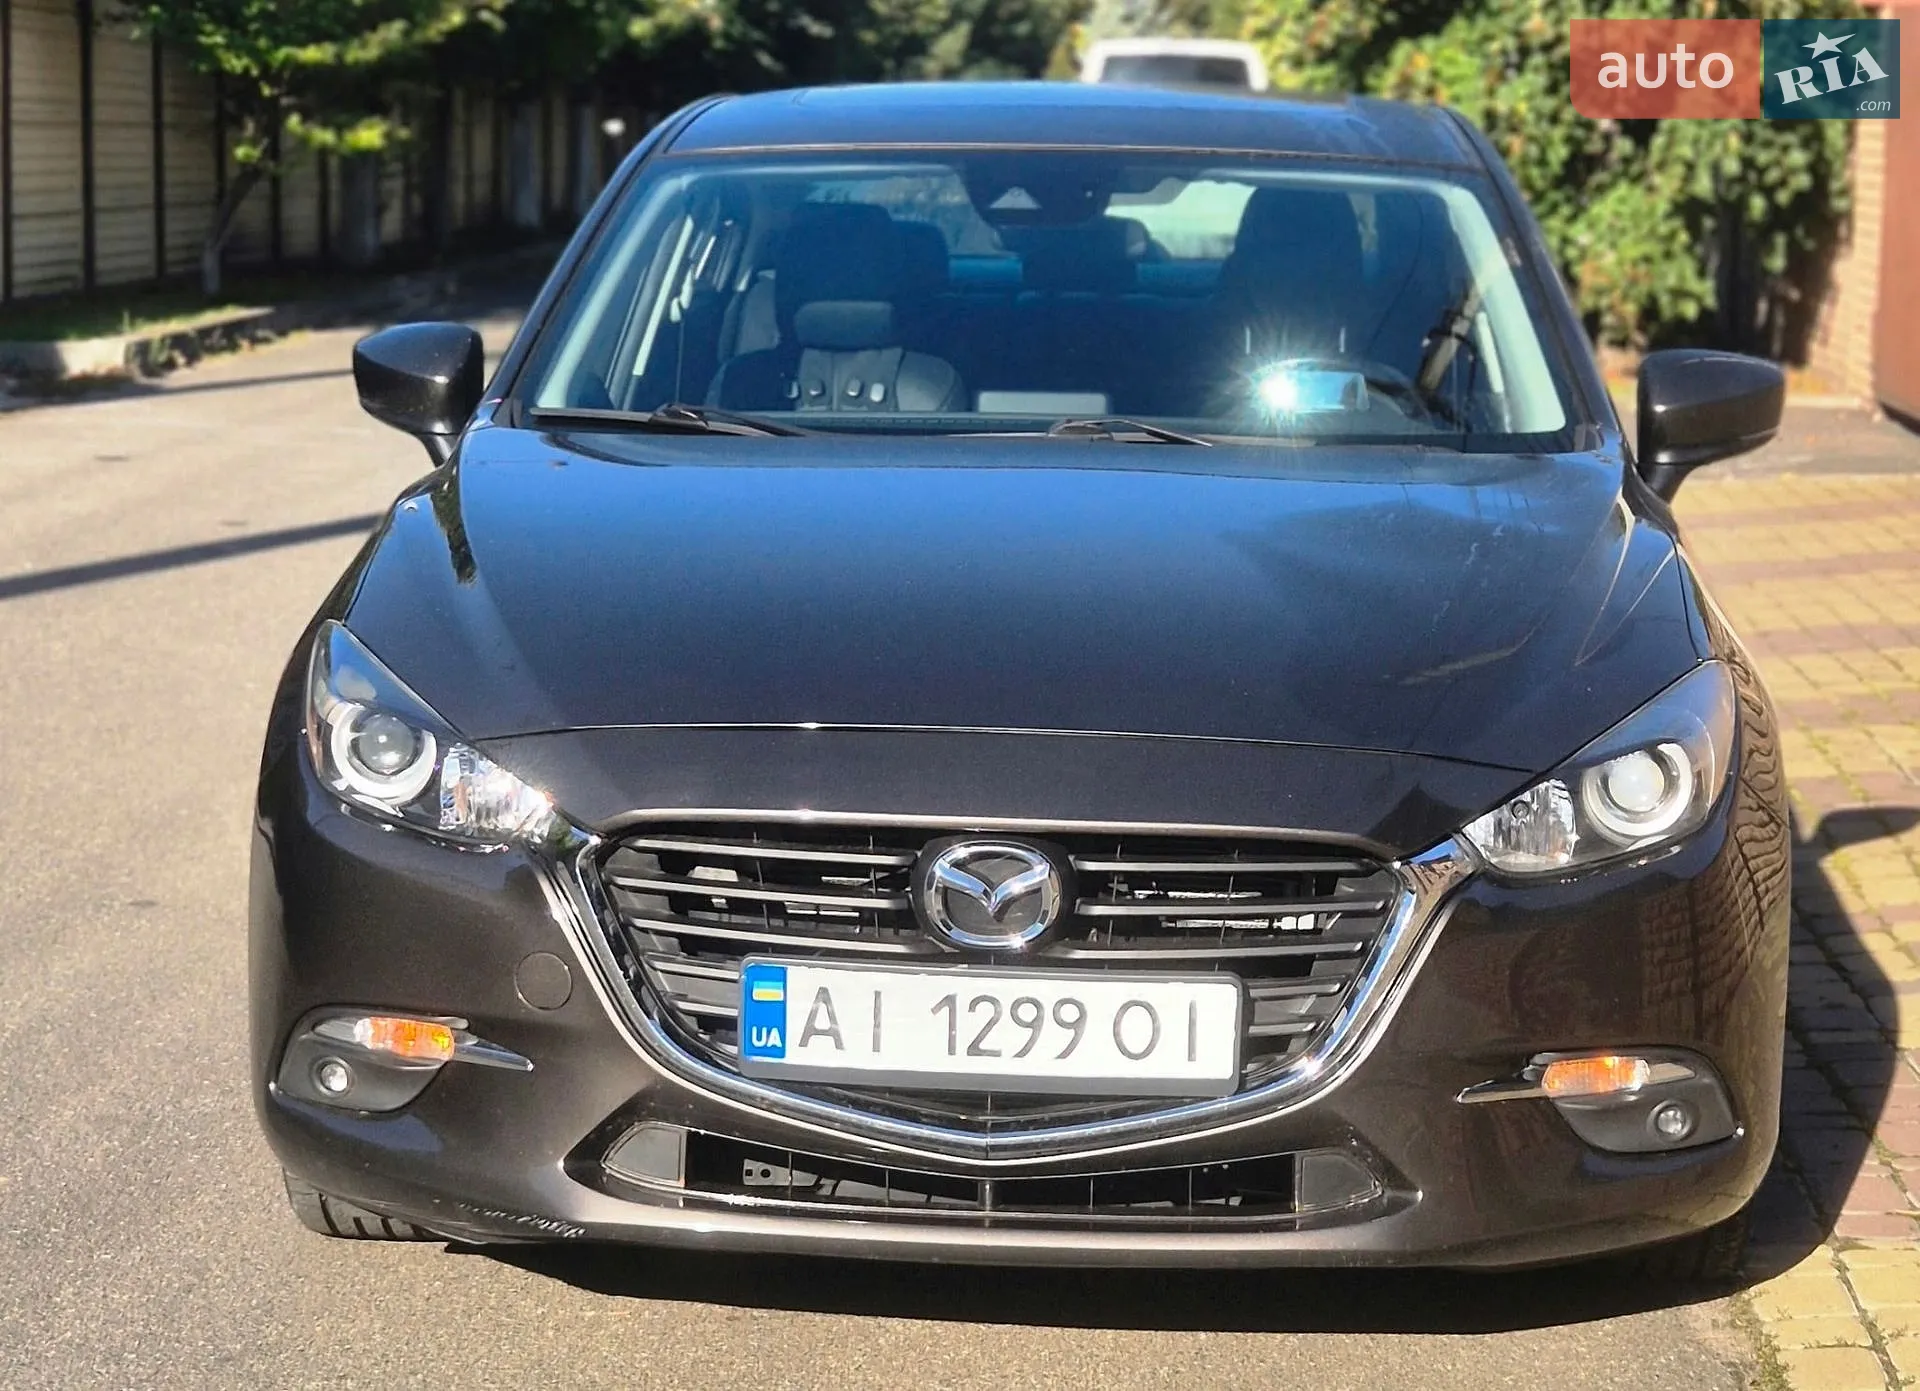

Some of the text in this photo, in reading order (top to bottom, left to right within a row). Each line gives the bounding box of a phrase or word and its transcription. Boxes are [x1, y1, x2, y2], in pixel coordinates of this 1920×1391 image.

[751, 1026, 783, 1048] UA
[797, 986, 1198, 1062] AI 1299 OI
